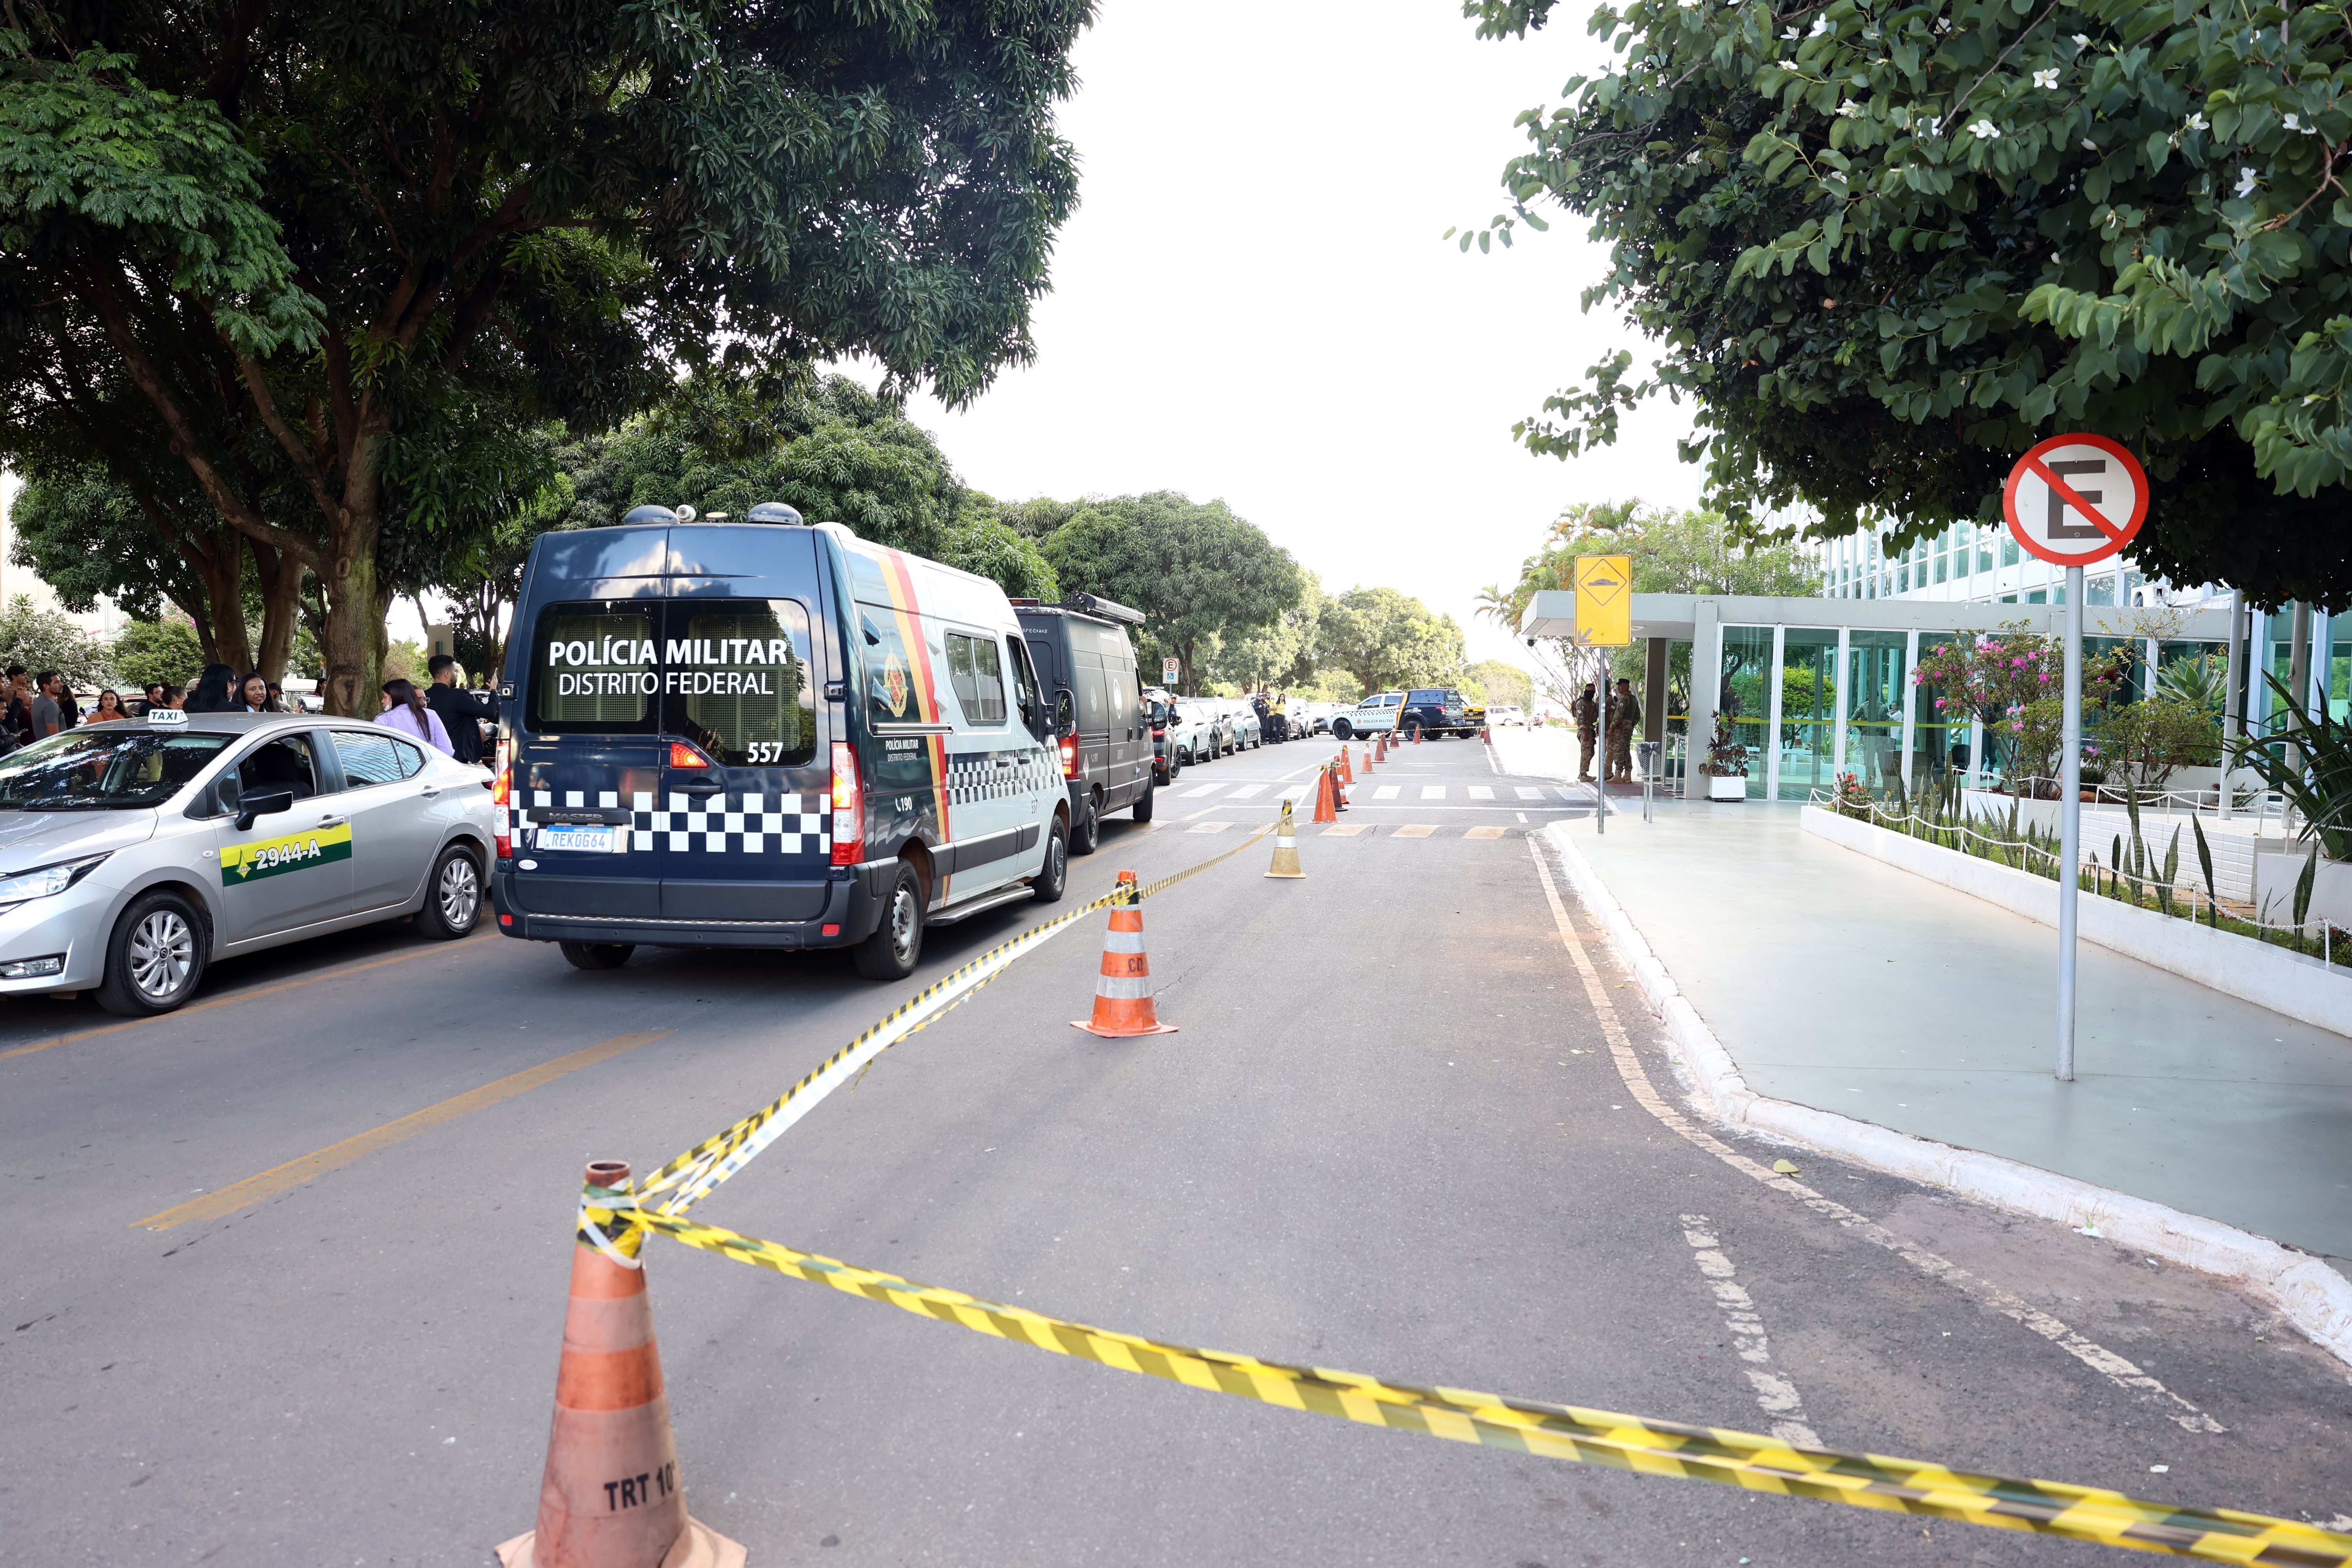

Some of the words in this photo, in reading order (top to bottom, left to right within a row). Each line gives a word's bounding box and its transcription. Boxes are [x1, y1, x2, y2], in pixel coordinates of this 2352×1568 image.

[2047, 460, 2106, 539] E
[549, 635, 657, 666] POLÍCIA
[665, 639, 787, 664] MILITAR
[559, 672, 659, 695] DISTRITO
[666, 672, 773, 695] FEDERAL
[151, 712, 178, 720] TAXI
[748, 742, 783, 762] 557
[886, 738, 902, 750] POLÍCIA
[902, 739, 918, 749] MILITAR
[887, 753, 903, 762] DISTRITO
[903, 752, 917, 760] FEDERAL
[901, 796, 912, 811] 190
[255, 838, 321, 870] 2944-A
[604, 1473, 649, 1512] TRT
